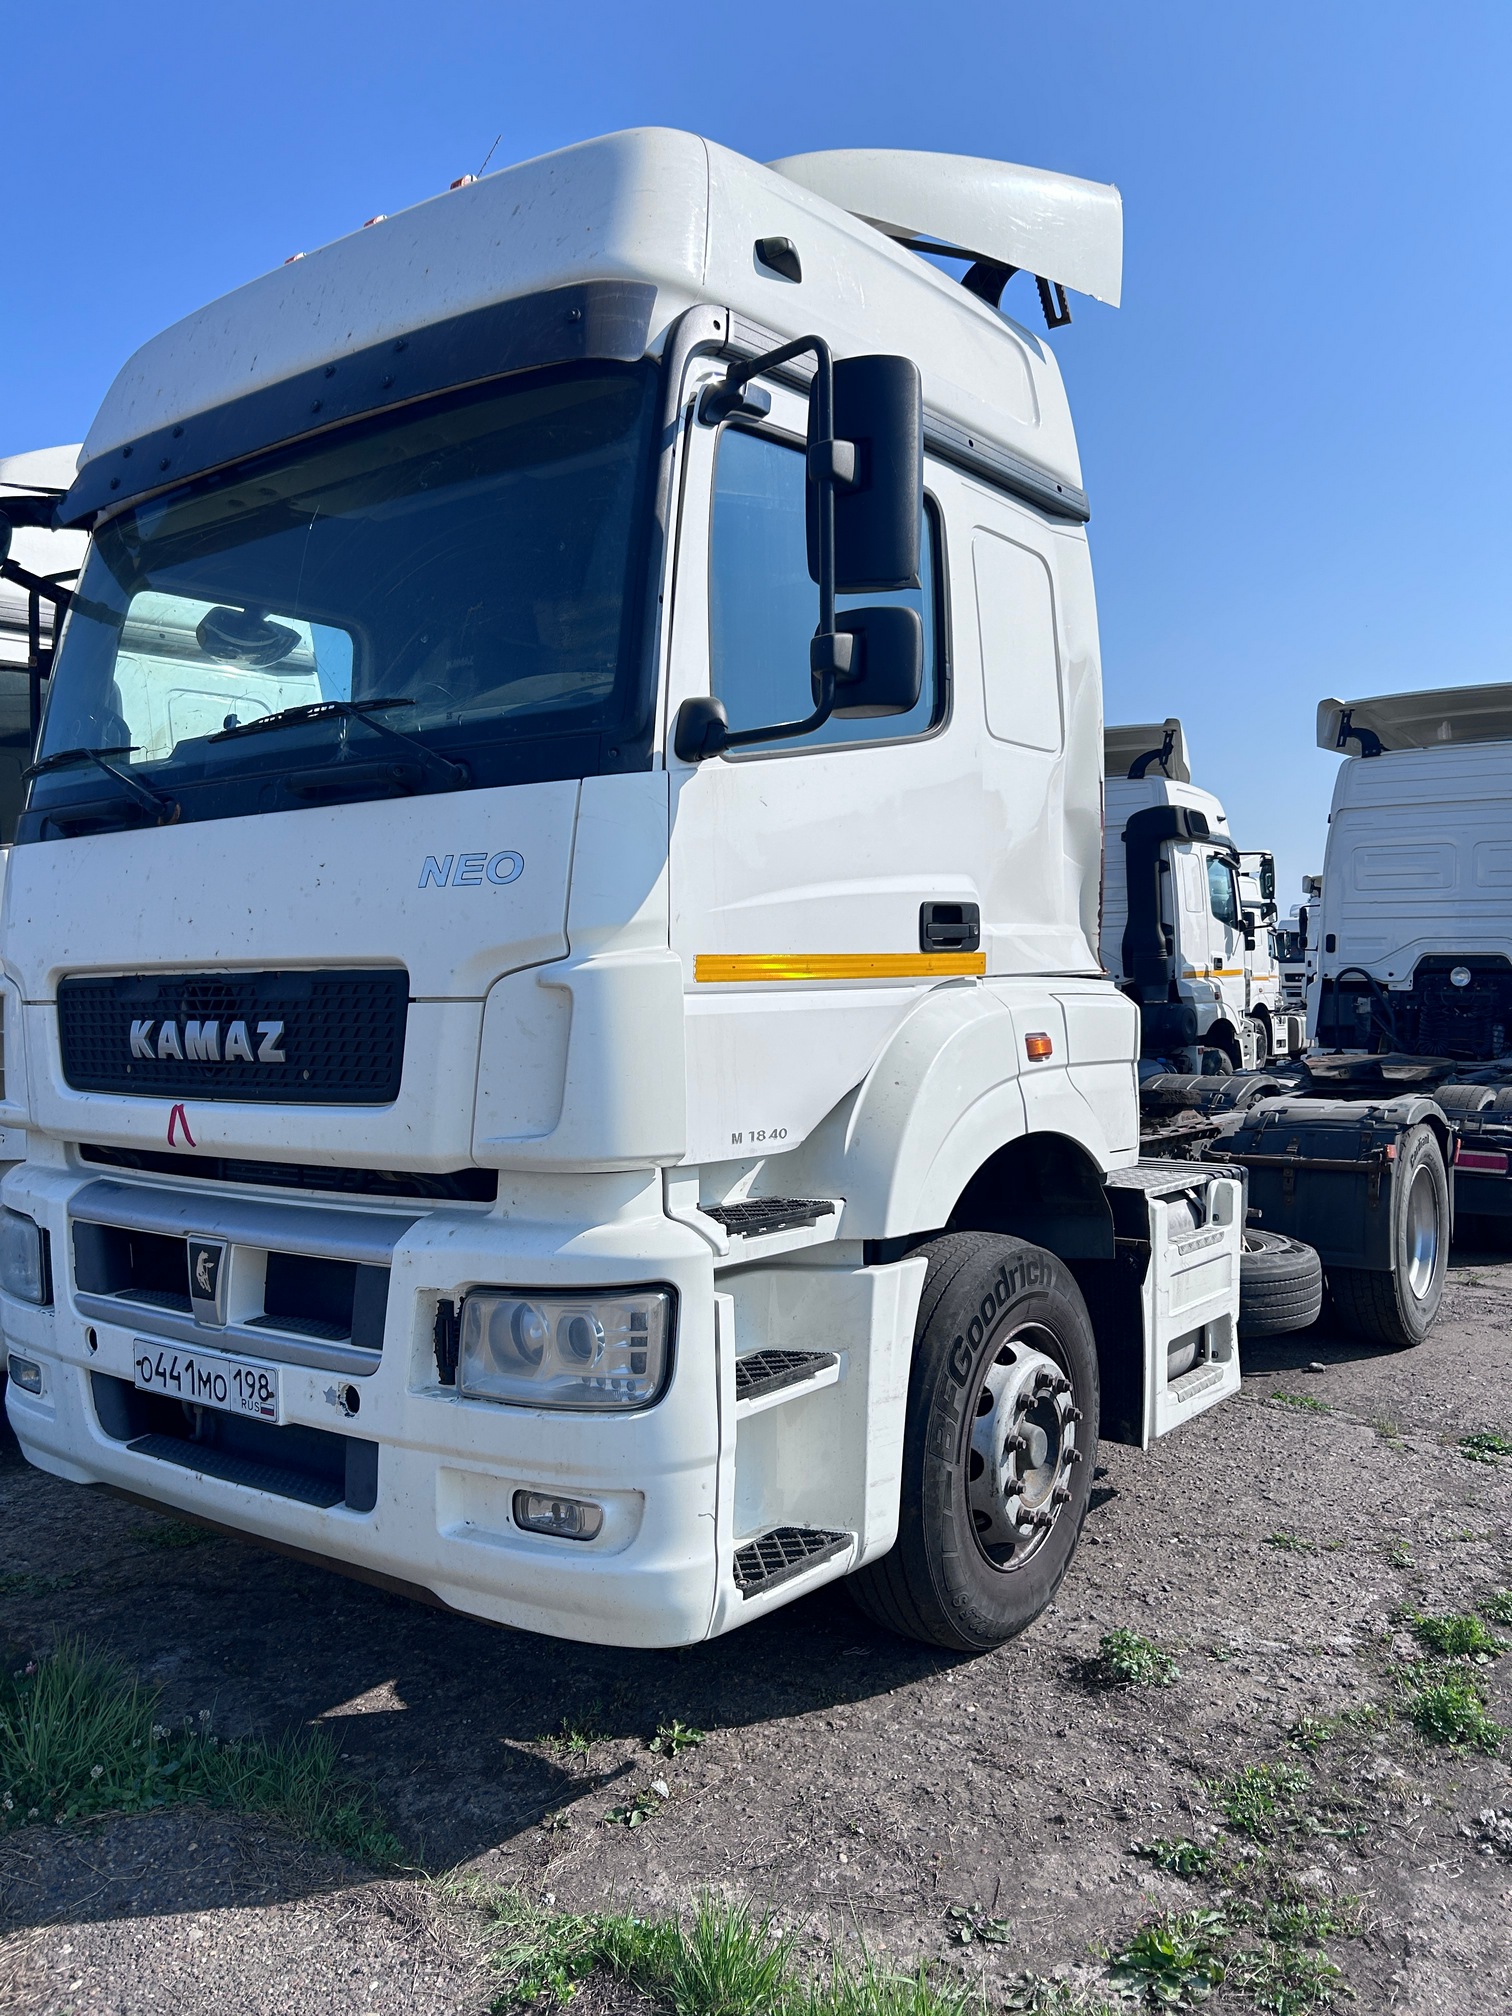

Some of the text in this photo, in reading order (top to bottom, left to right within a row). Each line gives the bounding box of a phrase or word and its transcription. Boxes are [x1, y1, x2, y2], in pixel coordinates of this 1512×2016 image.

[418, 850, 524, 888] NEO
[129, 1019, 286, 1062] KAMAZ
[731, 1132, 743, 1145] M
[929, 1255, 1053, 1465] BFGoodrich
[233, 1368, 270, 1402] 198
[241, 1398, 260, 1412] RUS
